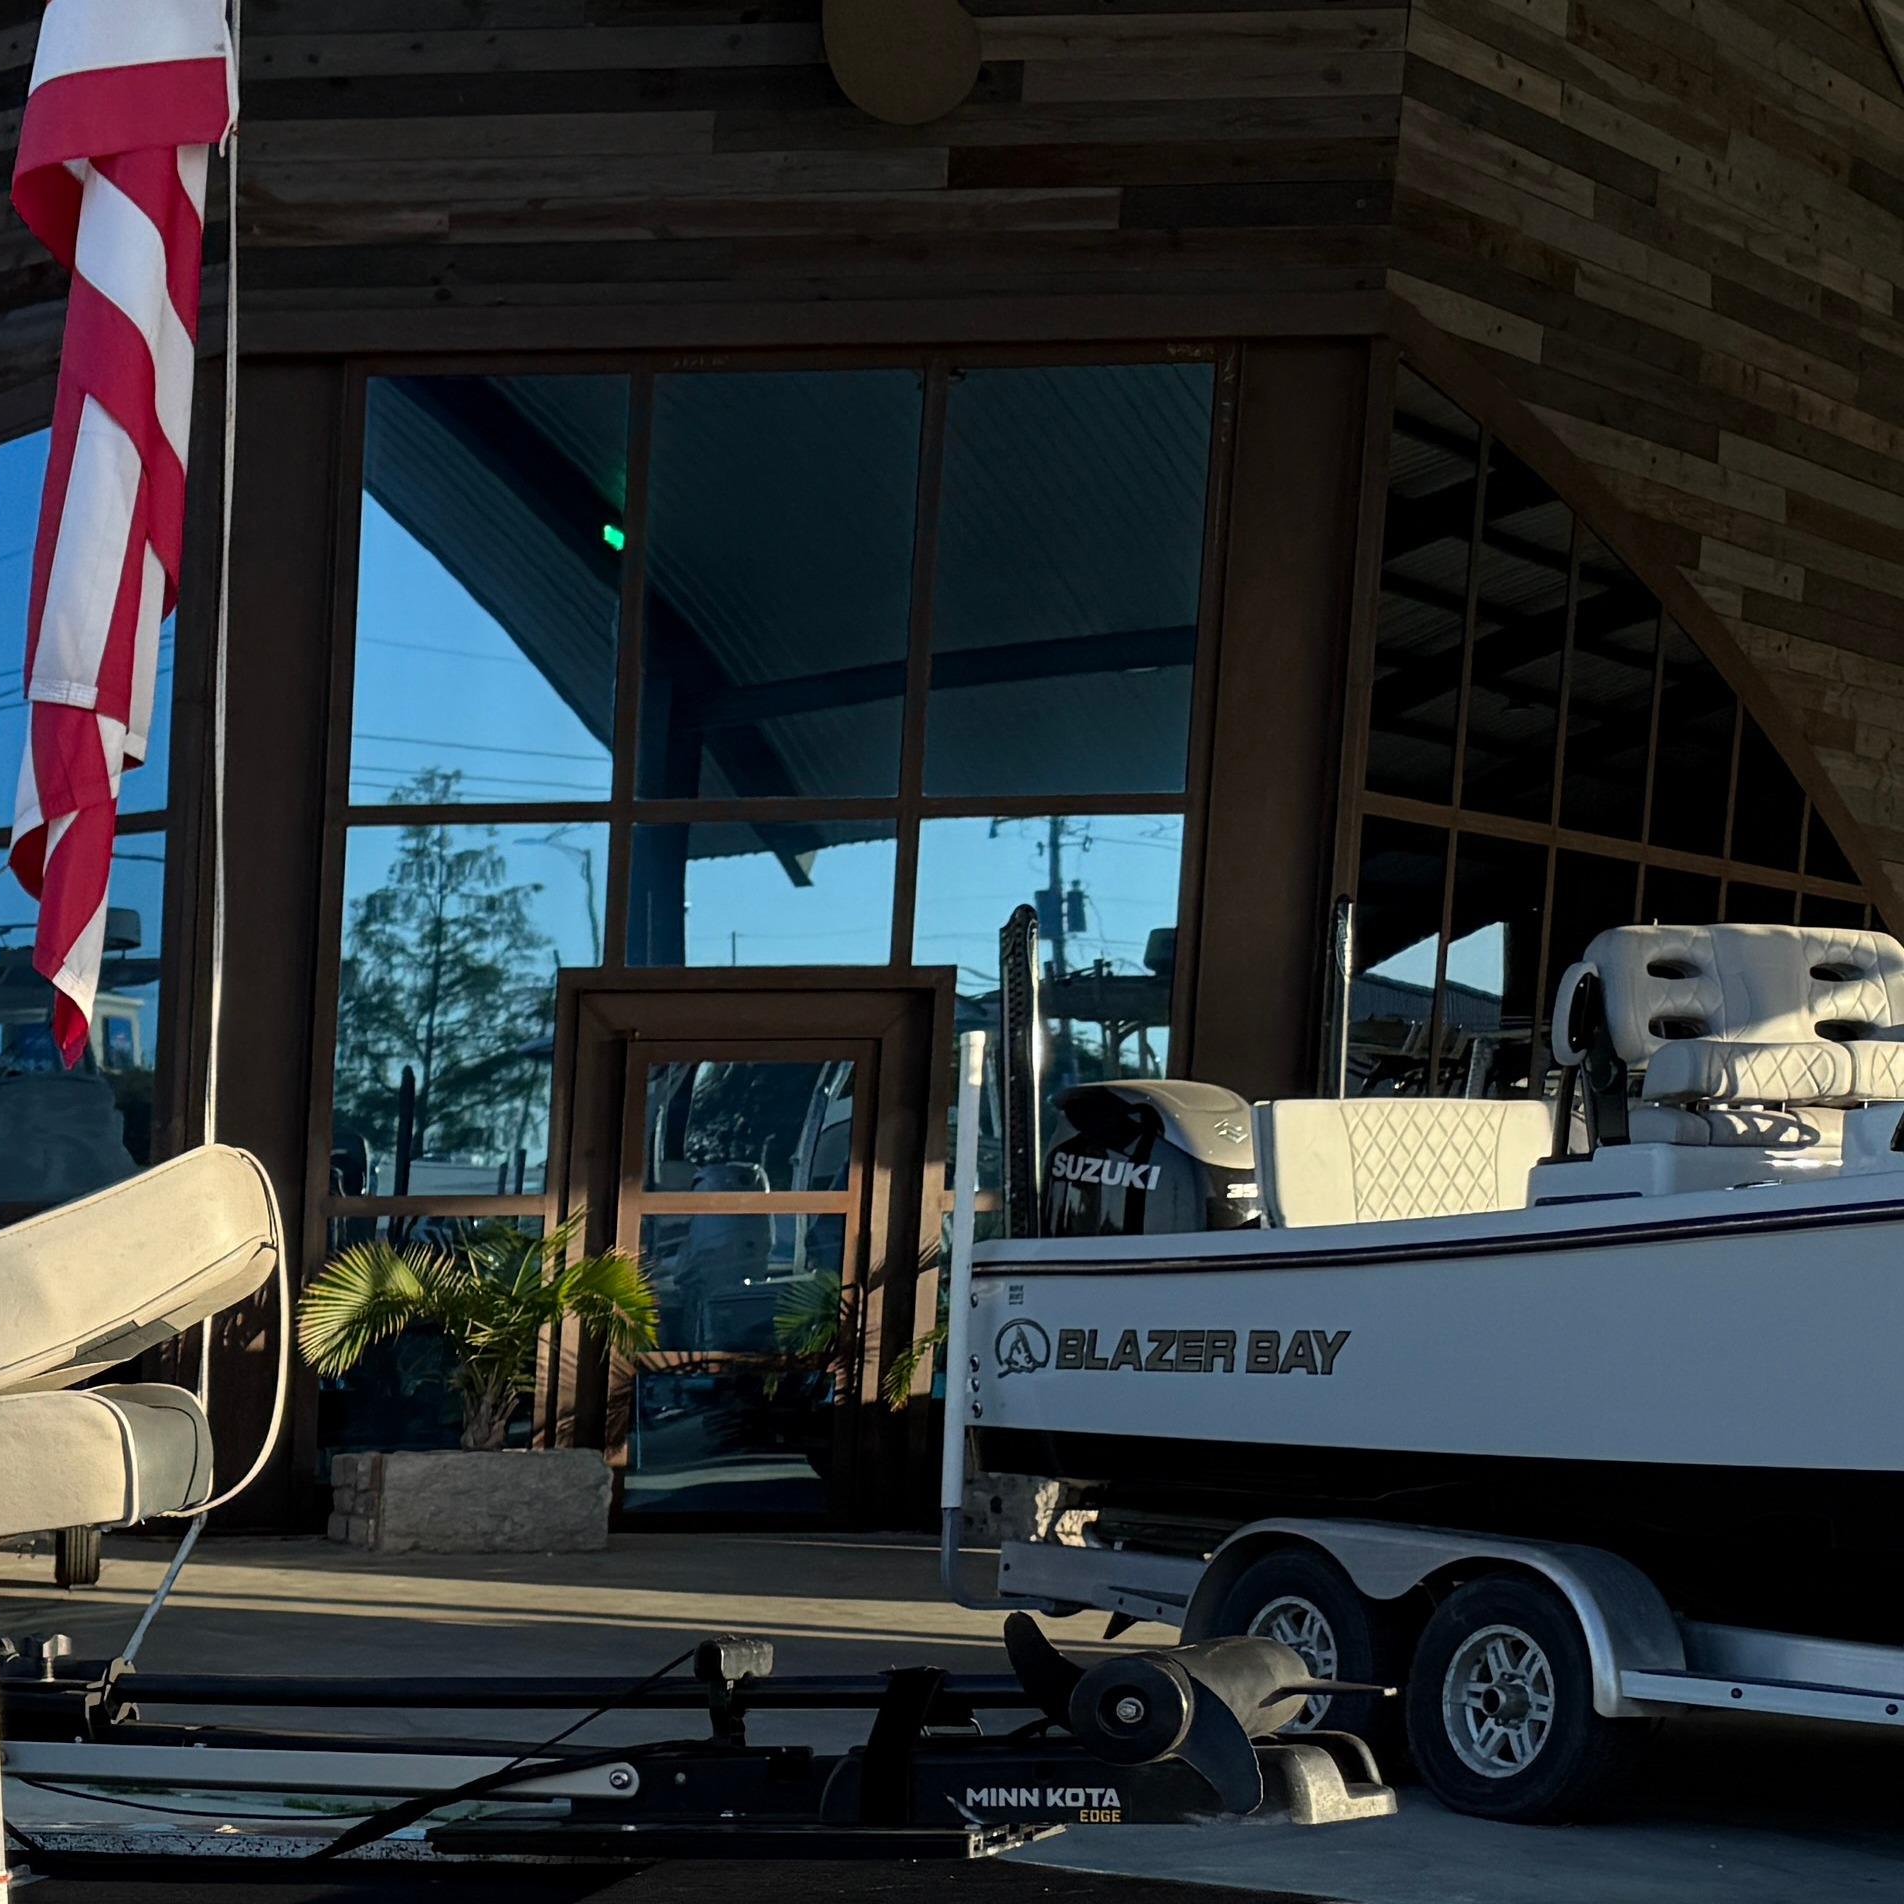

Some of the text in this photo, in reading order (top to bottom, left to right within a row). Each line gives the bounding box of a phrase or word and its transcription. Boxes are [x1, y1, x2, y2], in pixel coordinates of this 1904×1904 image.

[1051, 1151, 1161, 1191] SUZUKI
[1226, 1183, 1259, 1199] 35
[1054, 1328, 1352, 1375] BLAZER BAY
[966, 1787, 1121, 1808] MINN KOTA
[1079, 1809, 1122, 1823] EDGE
